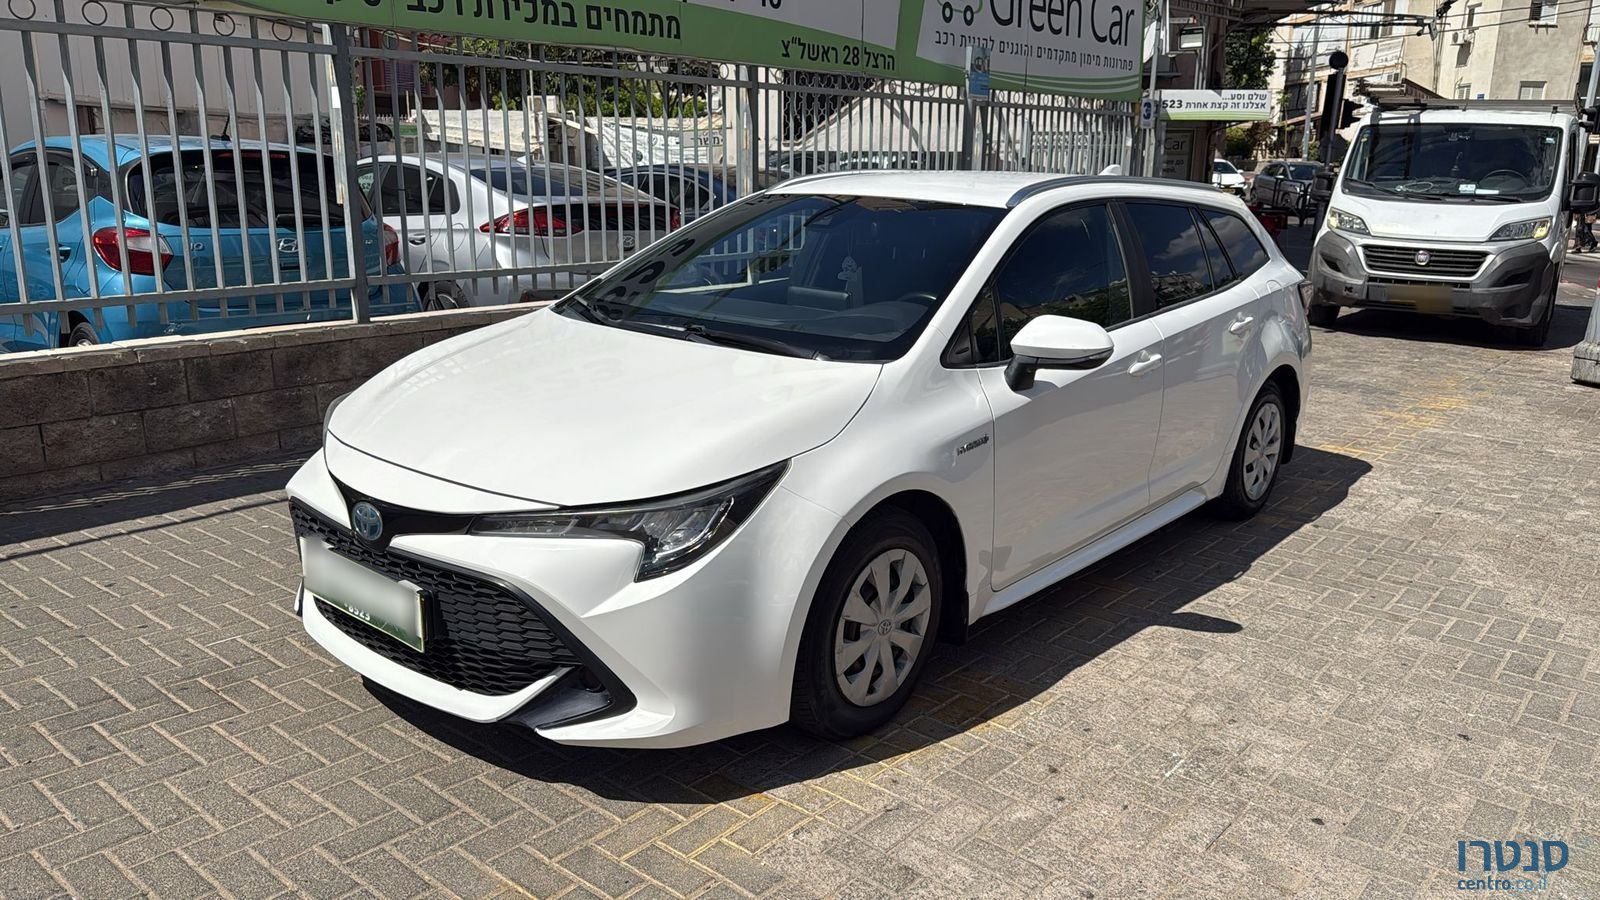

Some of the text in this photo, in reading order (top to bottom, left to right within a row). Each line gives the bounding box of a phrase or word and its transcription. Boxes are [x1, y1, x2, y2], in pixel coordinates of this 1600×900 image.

[586, 5, 681, 39] מתמחים
[1090, 0, 1135, 46] Car
[935, 30, 955, 46] רכב
[842, 45, 860, 66] 28
[999, 40, 1033, 57] והוגנים
[1037, 46, 1077, 64] מתקדמים
[864, 47, 895, 71] הרצל
[1079, 54, 1101, 68] מימון
[1103, 56, 1134, 71] פתרונות
[1248, 92, 1267, 101] שלם
[1185, 101, 1208, 109] אחרת
[1210, 102, 1229, 110] קצת
[1243, 101, 1267, 109] אצלנו
